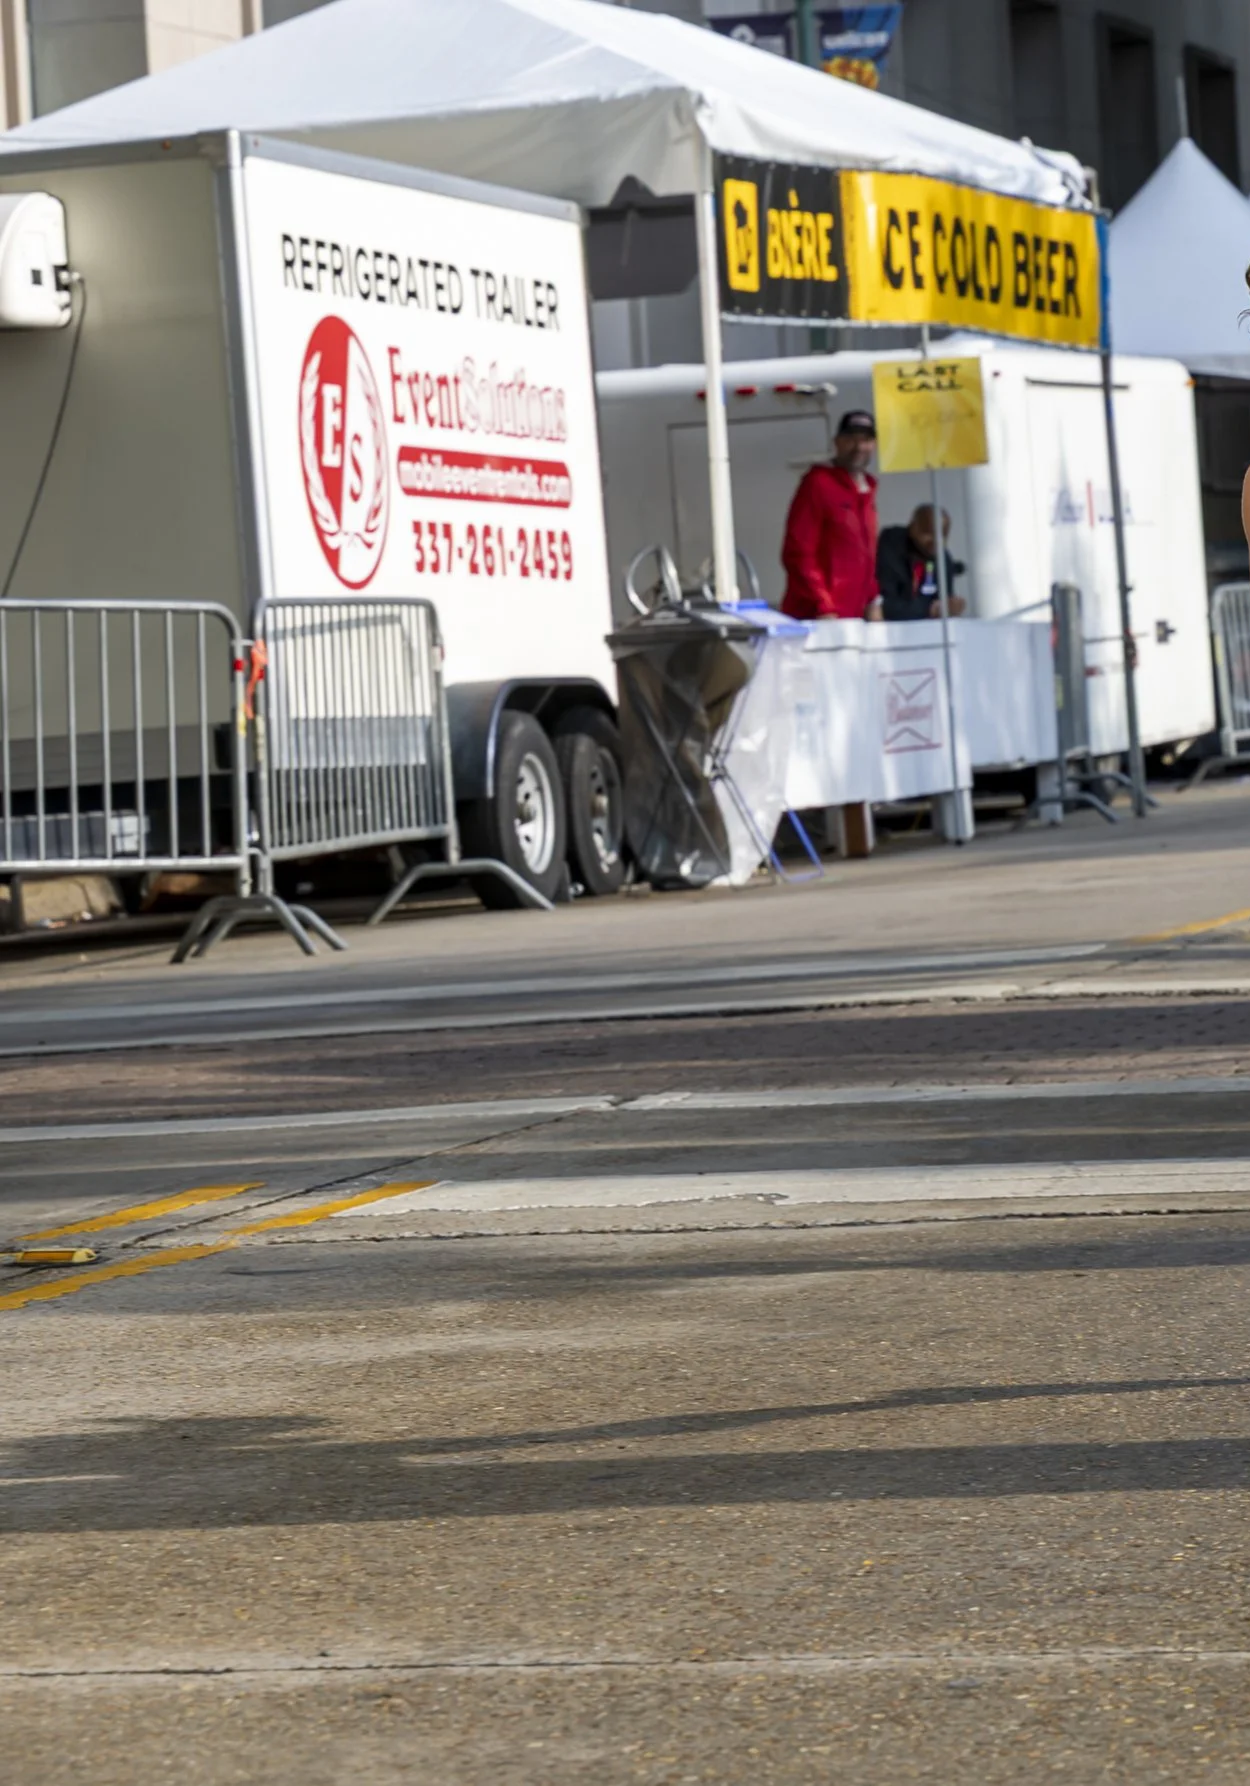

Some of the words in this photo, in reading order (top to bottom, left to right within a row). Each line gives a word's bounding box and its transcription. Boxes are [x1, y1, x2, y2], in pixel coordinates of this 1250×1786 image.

[282, 234, 464, 314] REFRIGERATED
[470, 268, 560, 331] TRAILER
[882, 208, 925, 290] CE
[933, 212, 1003, 304] COLD
[1013, 231, 1081, 319] BEER
[897, 364, 961, 379] LAST
[897, 379, 963, 392] CALL
[412, 520, 573, 581] 337-261-2459
